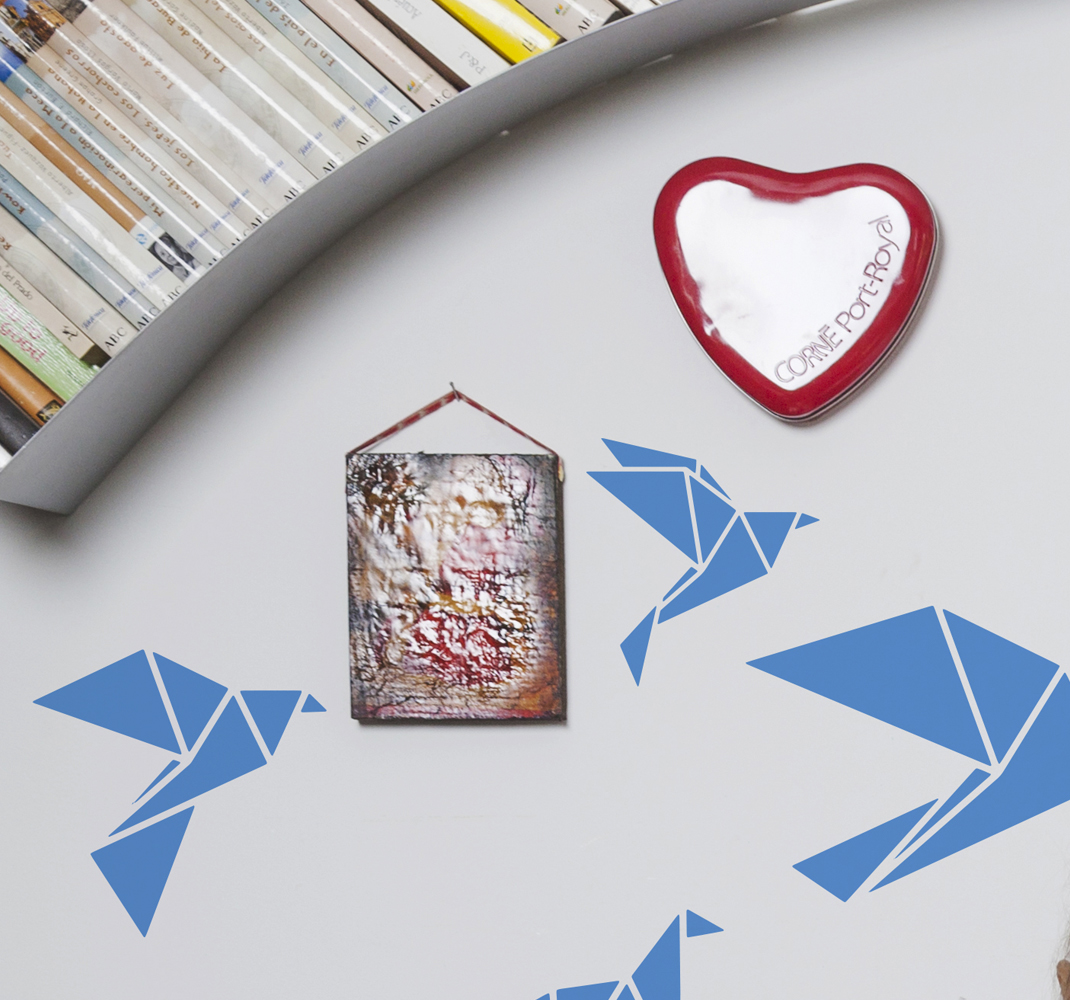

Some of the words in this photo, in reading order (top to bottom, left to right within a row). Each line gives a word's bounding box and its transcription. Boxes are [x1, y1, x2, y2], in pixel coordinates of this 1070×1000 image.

[262, 0, 279, 15] de
[96, 18, 138, 56] agosto
[174, 24, 190, 39] de
[245, 32, 266, 52] Los
[302, 36, 318, 52] el
[137, 54, 153, 69] de
[209, 56, 227, 73] La
[317, 48, 336, 67] En
[459, 49, 486, 75] P&J
[63, 47, 120, 99] cachorros
[151, 67, 175, 90] Luz
[44, 66, 87, 105] Habana
[22, 86, 54, 116] Meca
[118, 97, 140, 117] Los
[101, 117, 117, 133] en
[116, 131, 158, 171] hombre
[172, 146, 194, 167] Los
[76, 135, 150, 203] peregrinación
[156, 168, 201, 210] Nuestro
[148, 201, 164, 217] Mi
[834, 215, 900, 333] Port-Royal
[11, 279, 35, 301] Prado
[102, 326, 128, 350] ABC
